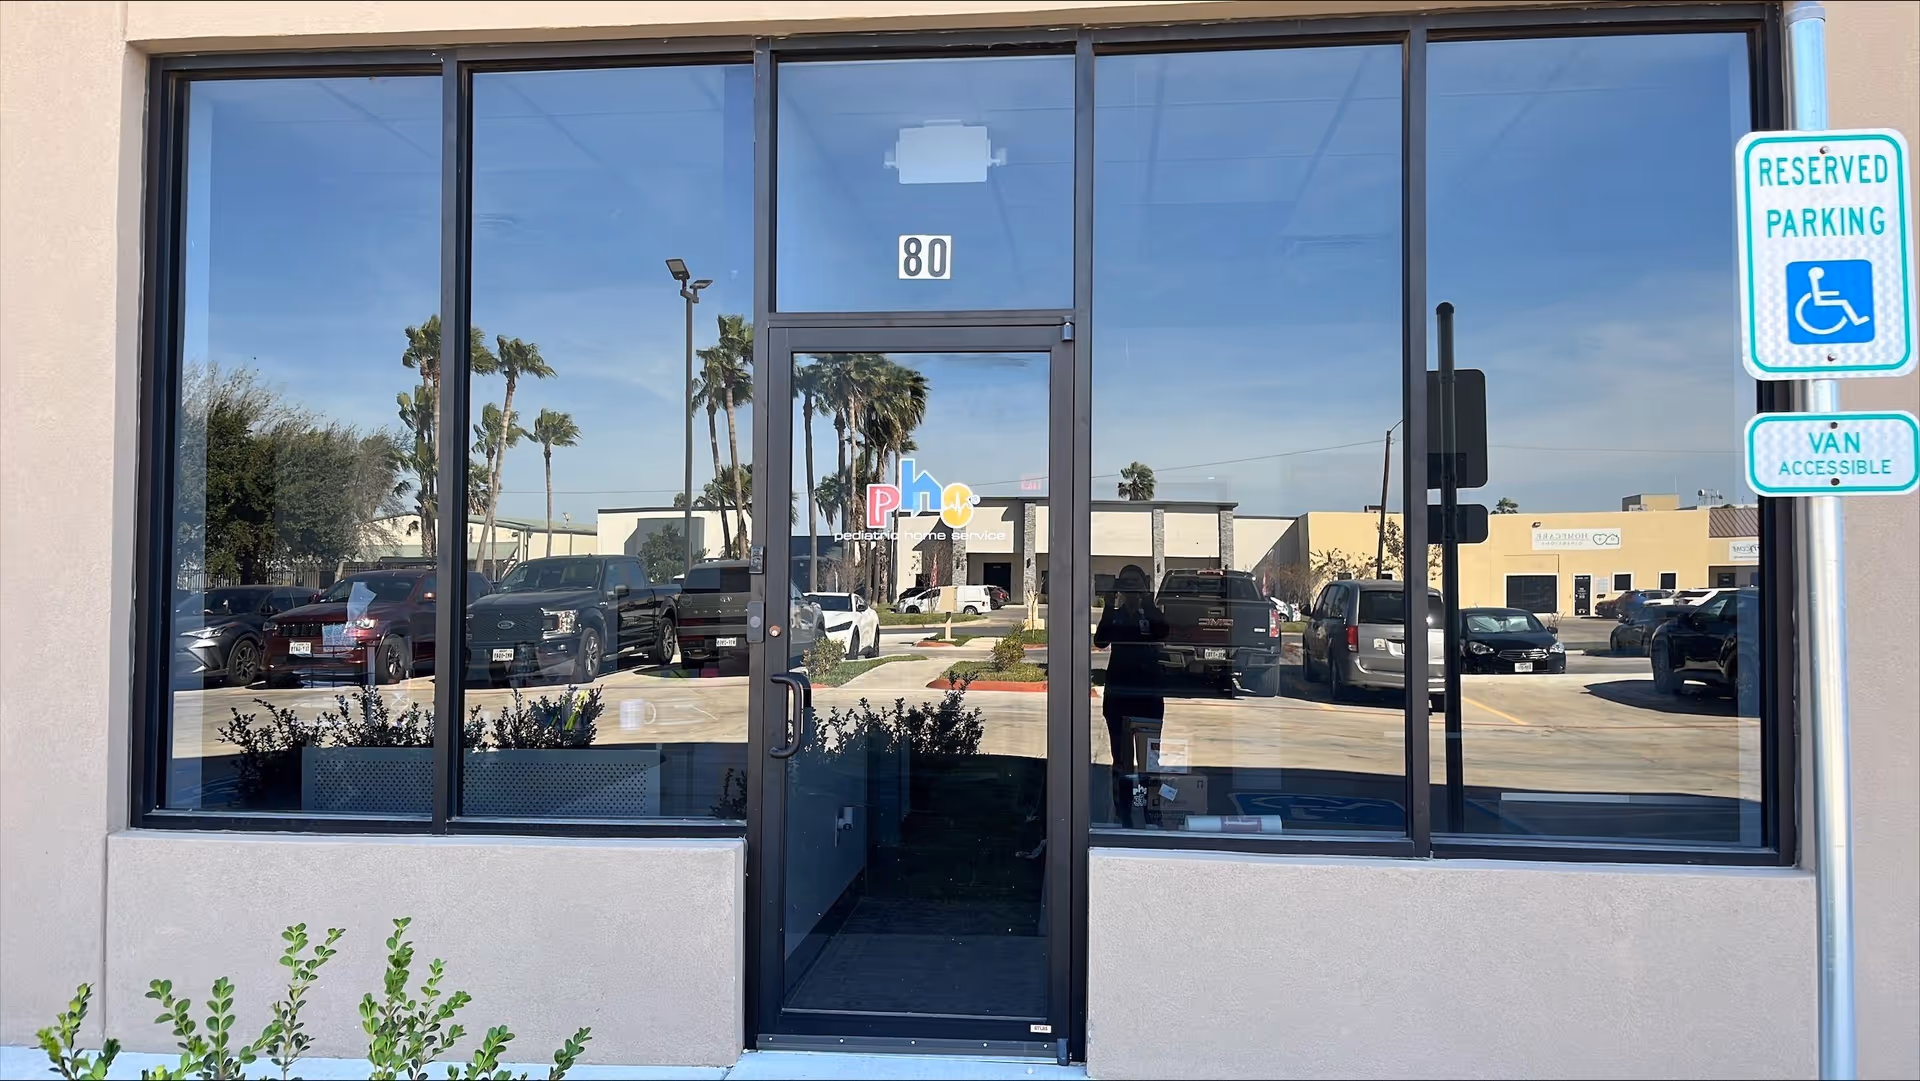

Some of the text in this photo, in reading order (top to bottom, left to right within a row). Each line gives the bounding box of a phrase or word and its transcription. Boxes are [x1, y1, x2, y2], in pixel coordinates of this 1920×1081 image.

[1758, 155, 1888, 186] RESERVED
[1767, 206, 1885, 238] PARKING
[903, 237, 947, 278] 80
[1808, 432, 1861, 454] VAN
[1778, 459, 1892, 475] ACCESSIBLE
[834, 530, 1006, 541] pediatric home service
